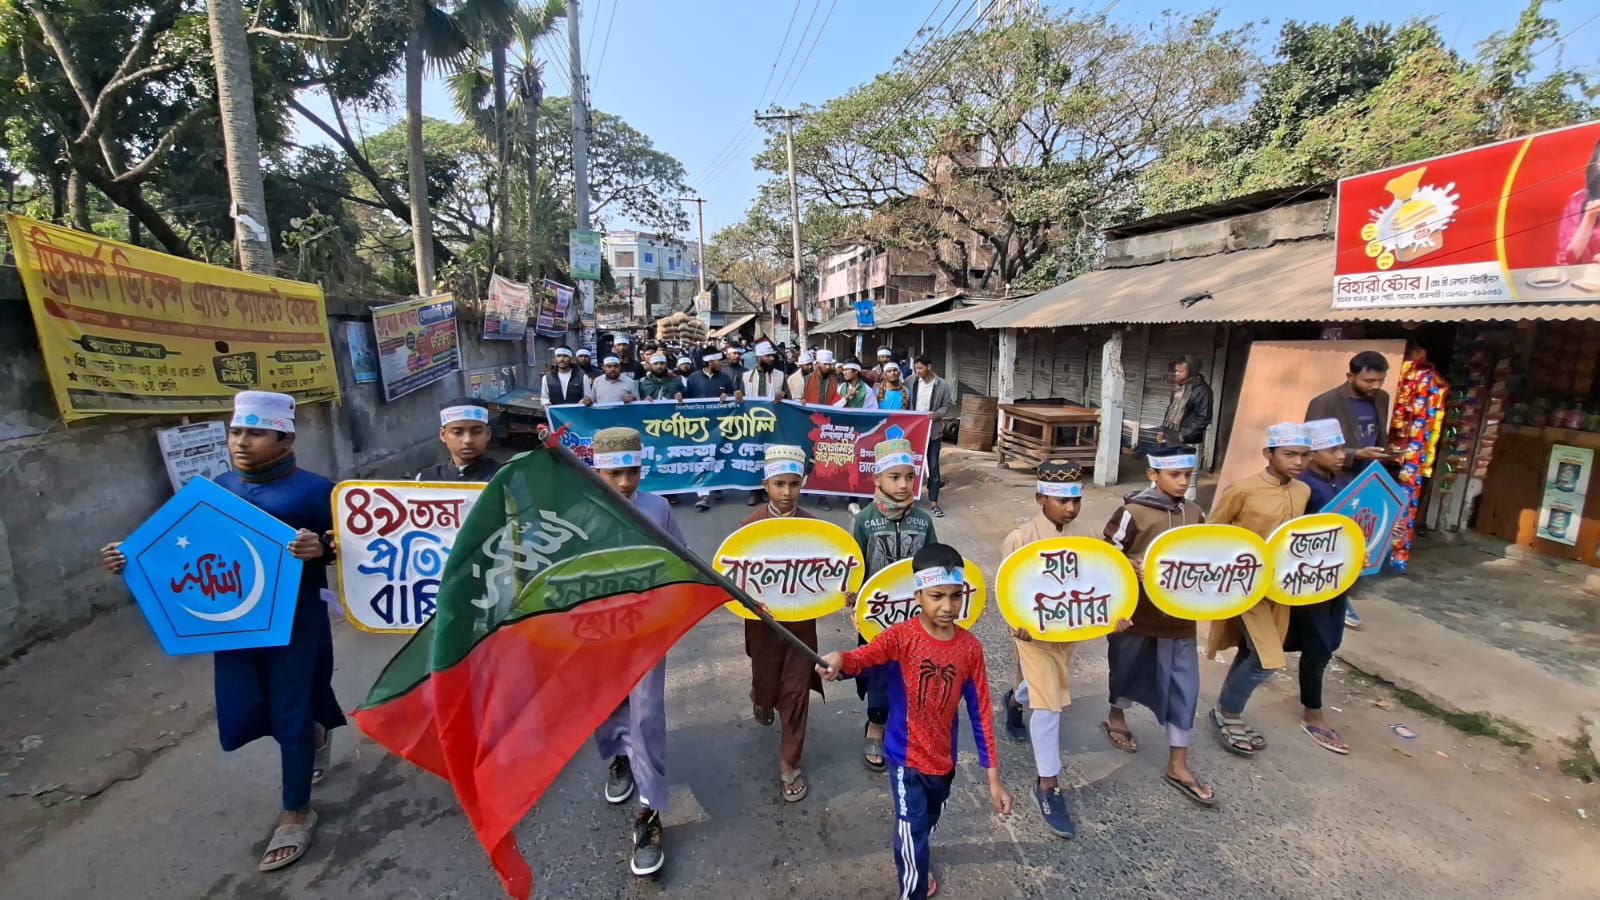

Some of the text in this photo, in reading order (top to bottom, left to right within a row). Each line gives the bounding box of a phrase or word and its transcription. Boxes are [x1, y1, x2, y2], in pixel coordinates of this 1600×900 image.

[643, 412, 710, 442] বর্ণাঢ্য
[720, 443, 735, 455] ও
[816, 452, 855, 468] বাংলাদেশ
[817, 438, 855, 455] আগামীর
[657, 456, 726, 475] আগামীর
[345, 488, 465, 537] ৪৯তম
[357, 531, 453, 582] প্রতি
[1290, 526, 1343, 559] জেলা
[720, 555, 858, 595] বাংলাদেশ
[1040, 550, 1079, 584] ছাত্র
[1159, 553, 1263, 595] রাজশাহী
[1282, 560, 1344, 596] পশ্চিম
[1033, 586, 1111, 632] শিবির
